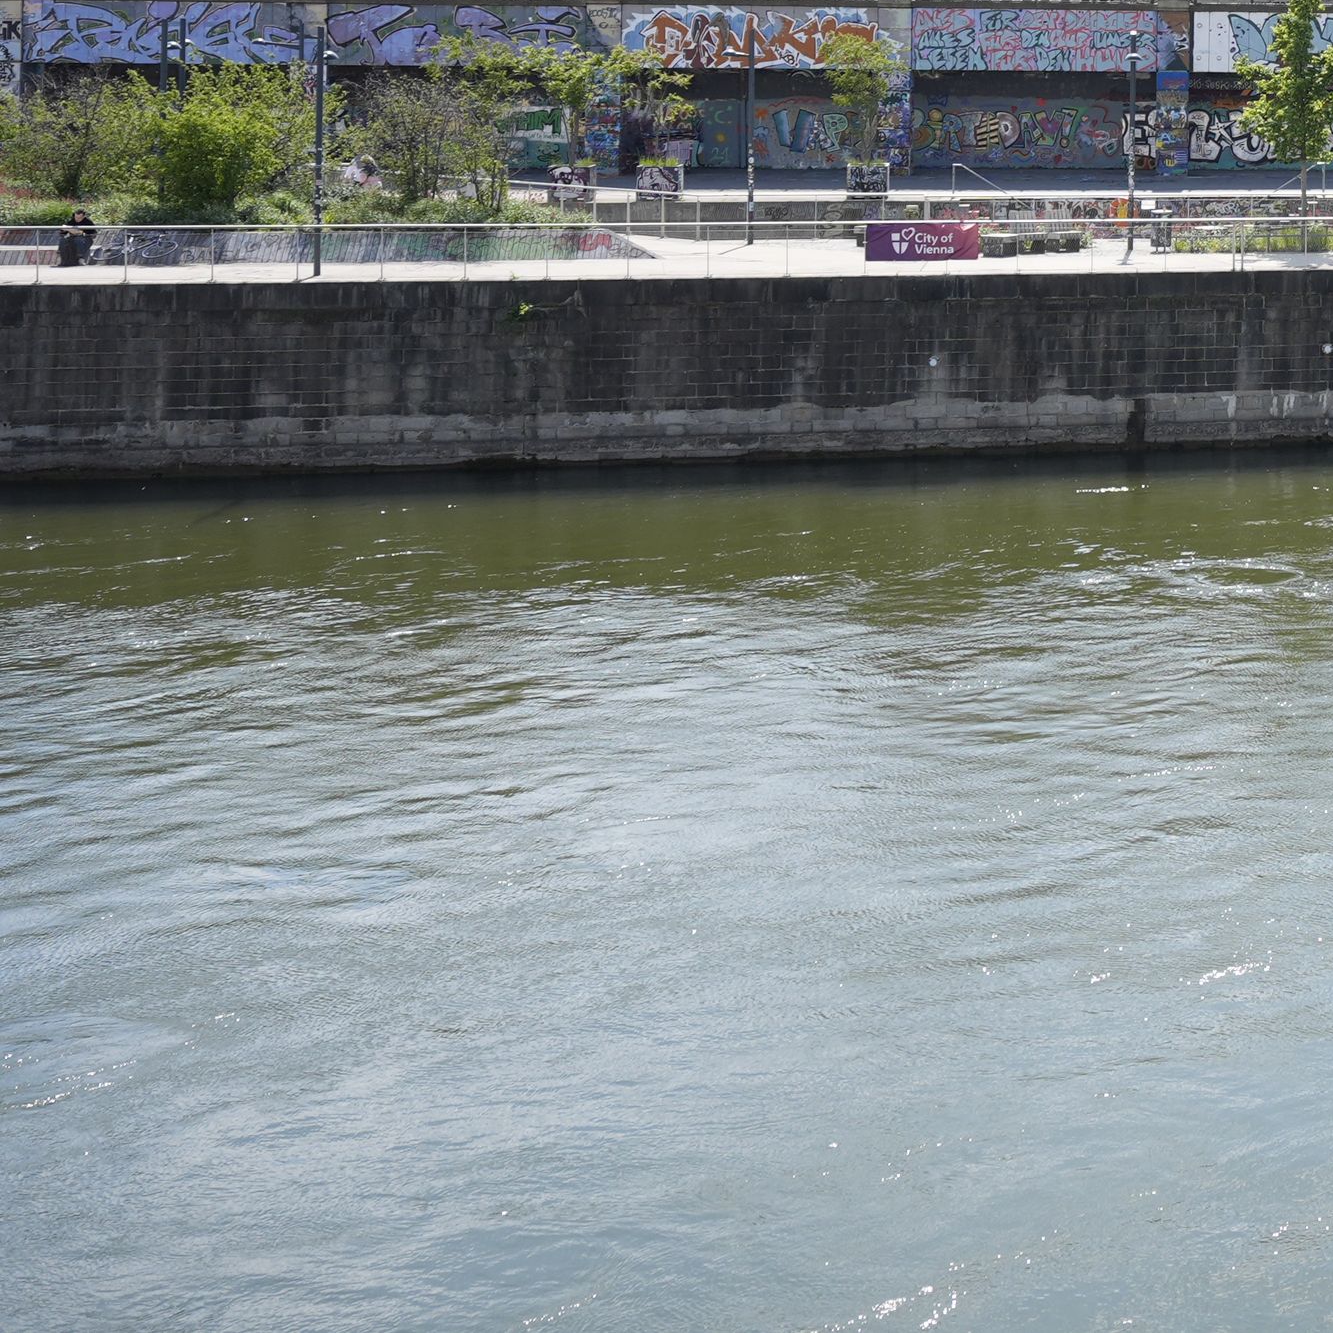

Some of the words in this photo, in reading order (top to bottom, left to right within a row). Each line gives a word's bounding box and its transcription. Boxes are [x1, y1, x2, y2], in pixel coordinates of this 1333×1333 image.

[914, 232, 938, 246] City
[940, 232, 954, 243] of
[914, 243, 955, 255] Vienna
